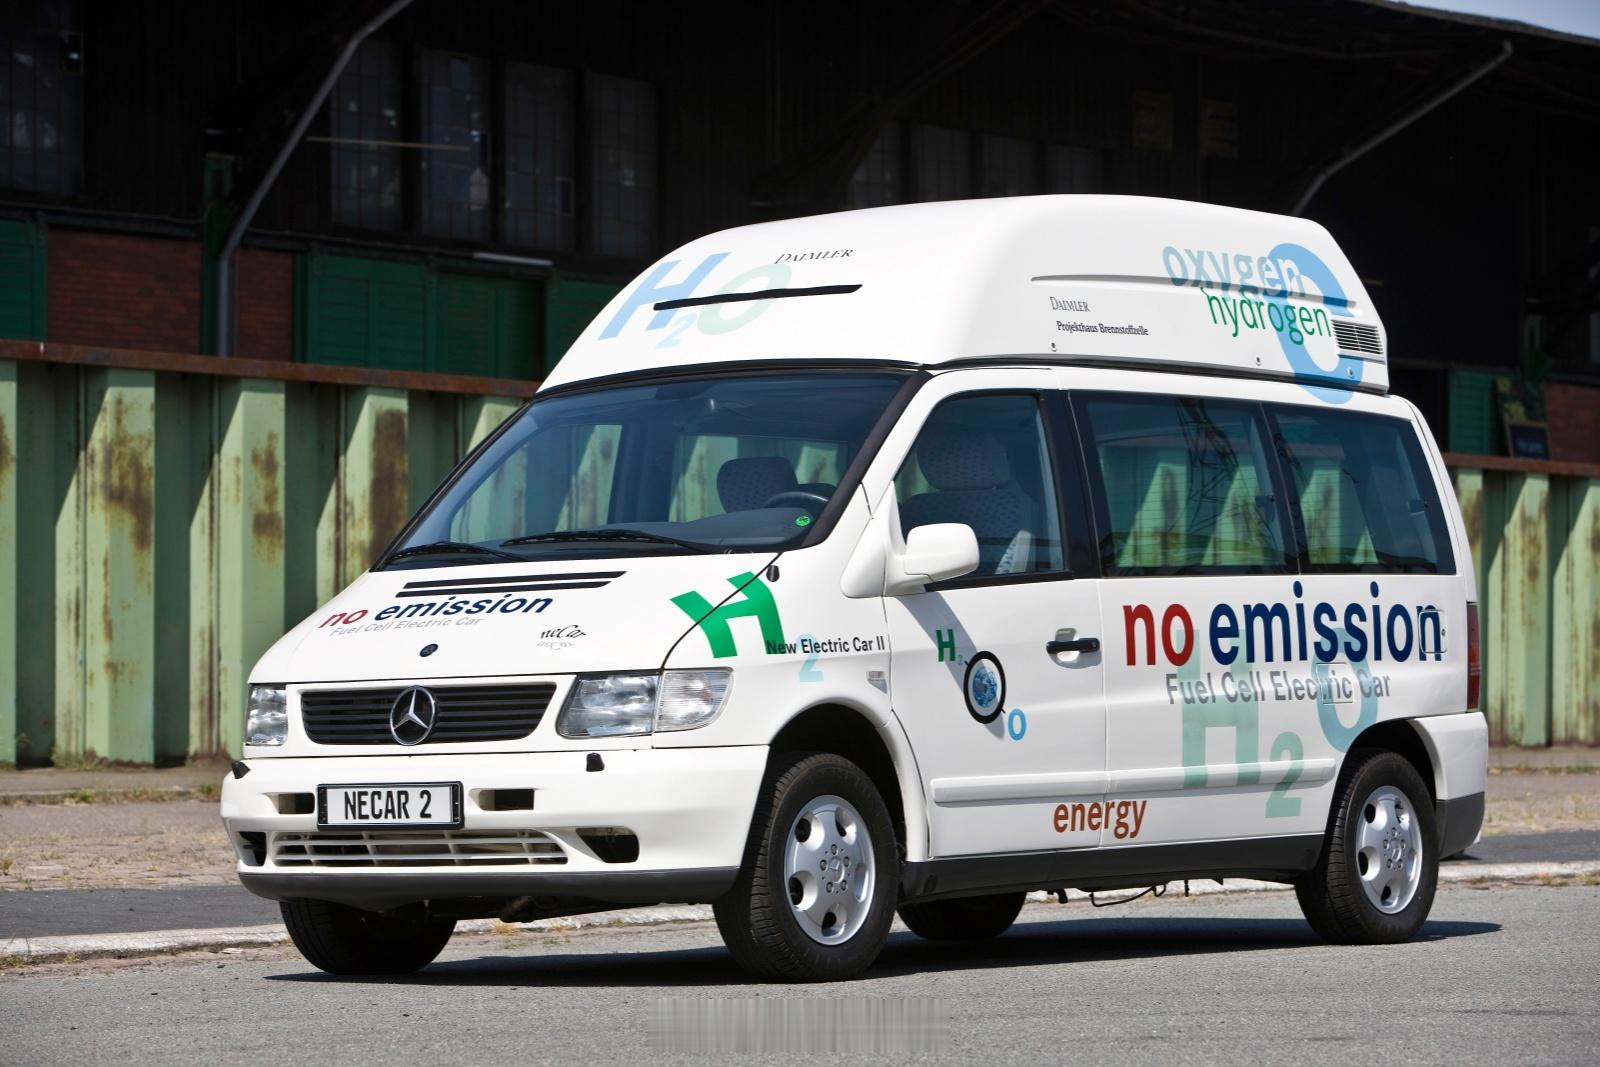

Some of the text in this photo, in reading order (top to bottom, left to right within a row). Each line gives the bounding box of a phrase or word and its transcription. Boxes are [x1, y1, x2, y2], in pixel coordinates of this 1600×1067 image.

[775, 249, 854, 264] DAIMLER
[1162, 245, 1307, 302] oxygen
[1049, 296, 1091, 312] DAIMLER
[1199, 286, 1332, 346] hydrogen
[1056, 320, 1098, 333] Projekthaus
[318, 593, 553, 629] no emission
[329, 616, 485, 637] Fuel Cell Electric Car
[1122, 580, 1442, 667] no emission
[766, 639, 797, 654] New
[800, 638, 850, 654] Electric
[852, 636, 873, 652] Car
[1165, 668, 1391, 704] Fuel Cell Electric Car
[344, 789, 432, 820] NECAR 2
[1053, 799, 1147, 840] energy
